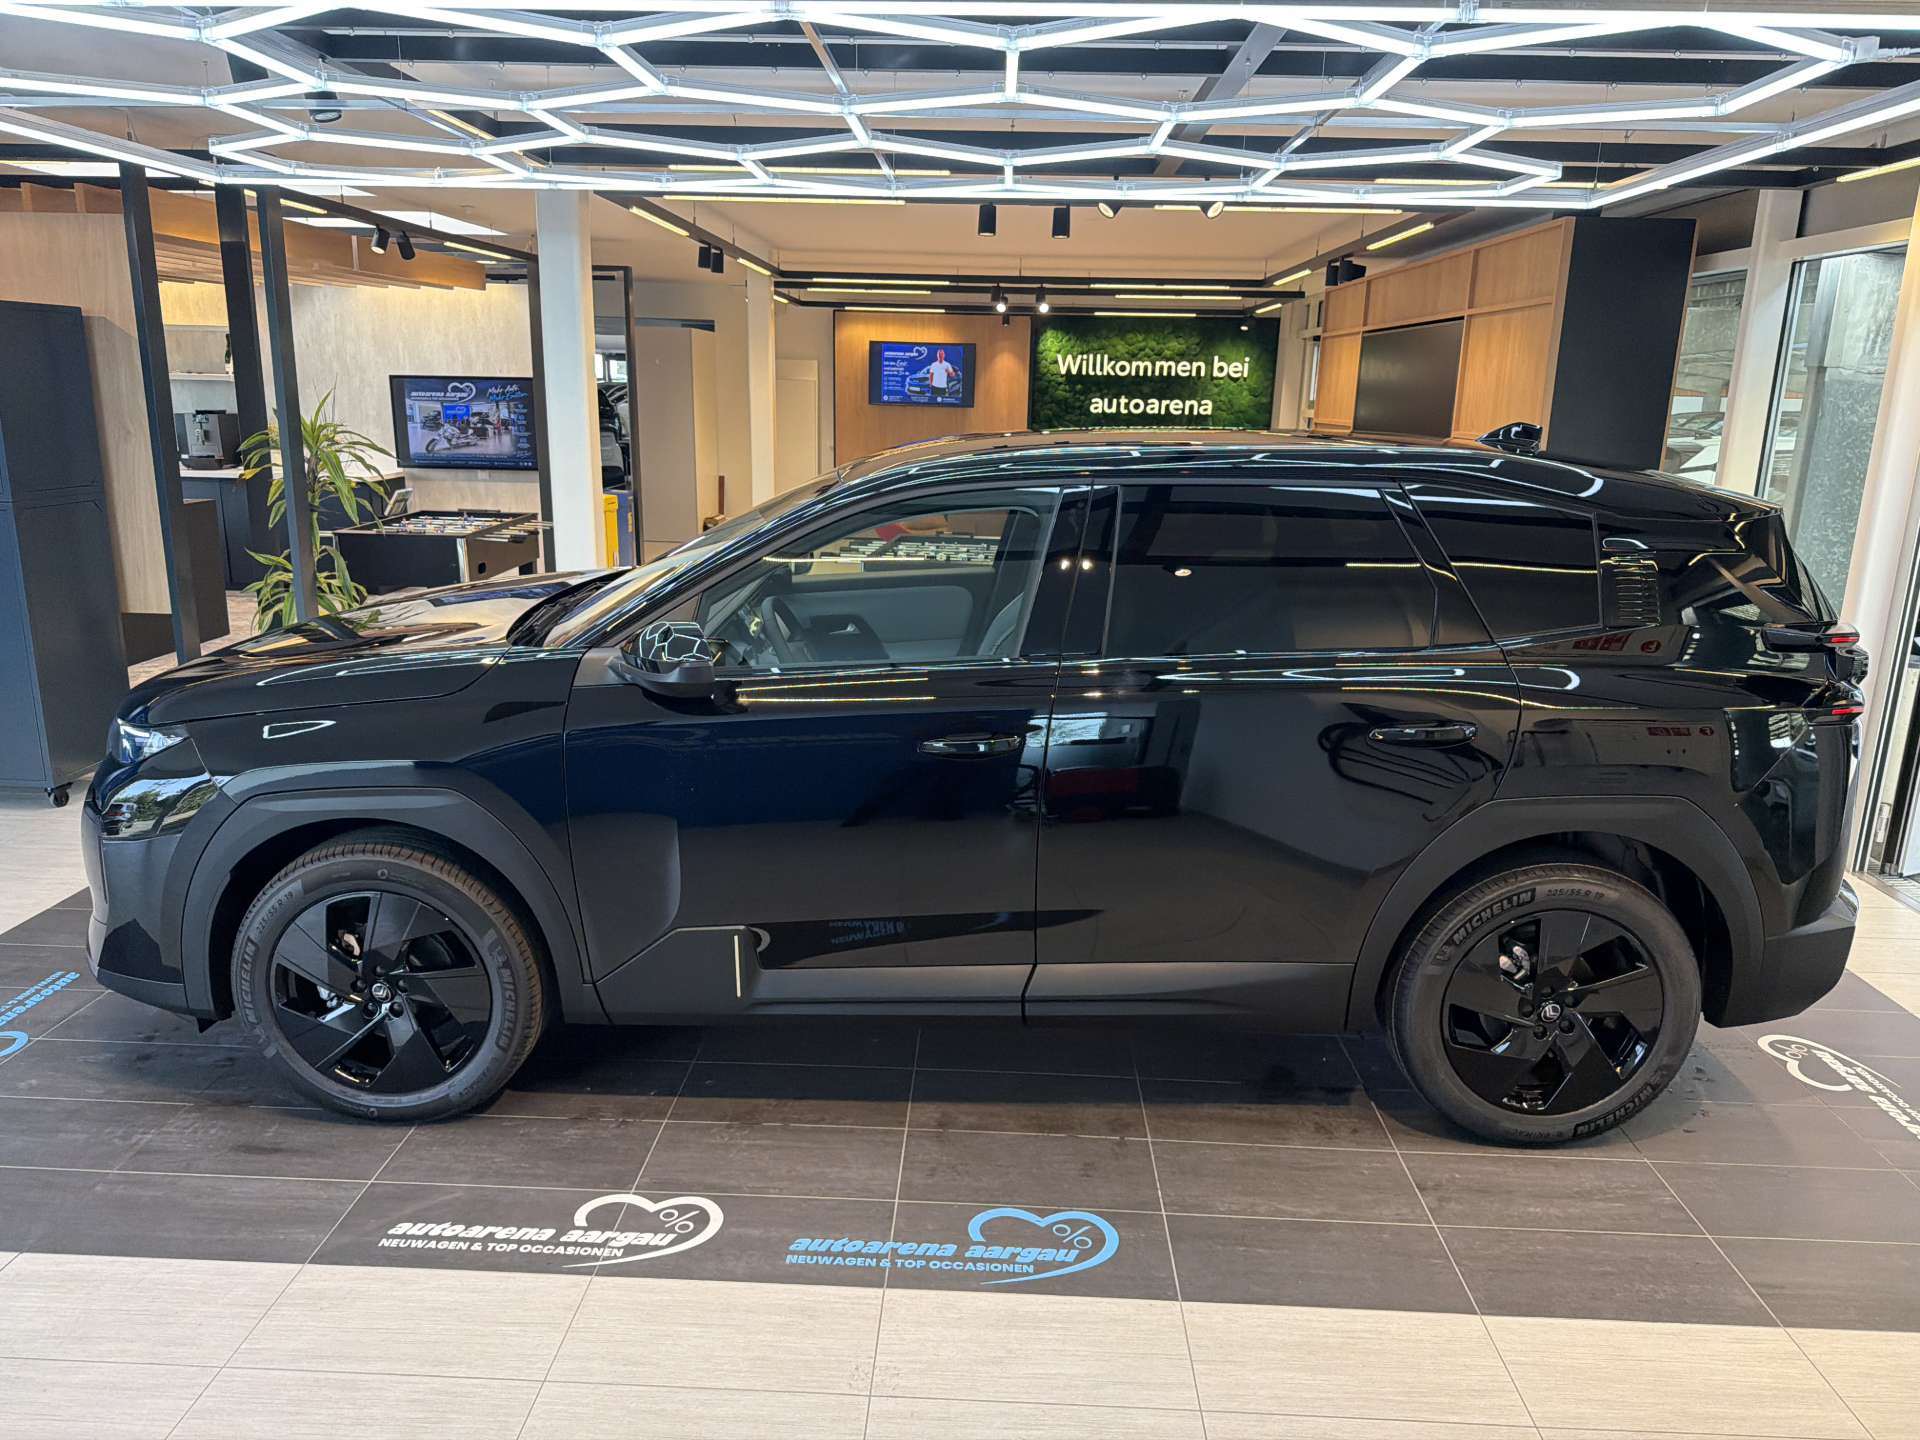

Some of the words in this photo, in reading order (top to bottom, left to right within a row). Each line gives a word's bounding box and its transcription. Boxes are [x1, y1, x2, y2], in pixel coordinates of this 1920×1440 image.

[1056, 353, 1206, 377] Willkommen
[1212, 355, 1250, 378] bei
[1089, 395, 1213, 415] autoarena
[1452, 891, 1533, 946] MICHELIN
[239, 940, 259, 1024] MICHELIN
[388, 1220, 556, 1242] autoarena
[559, 1227, 678, 1248] aargau
[378, 1237, 468, 1251] NEUWAGEN
[471, 1242, 483, 1251] &
[487, 1242, 518, 1252] TOP
[519, 1244, 624, 1258] OCCASIONEN
[788, 1237, 959, 1258] autoarena
[964, 1243, 1081, 1264] aargau
[785, 1253, 878, 1268] NEUWAGEN
[880, 1258, 892, 1268] &
[896, 1258, 927, 1269] TOP
[929, 1259, 1035, 1274] OCCASIONEN
